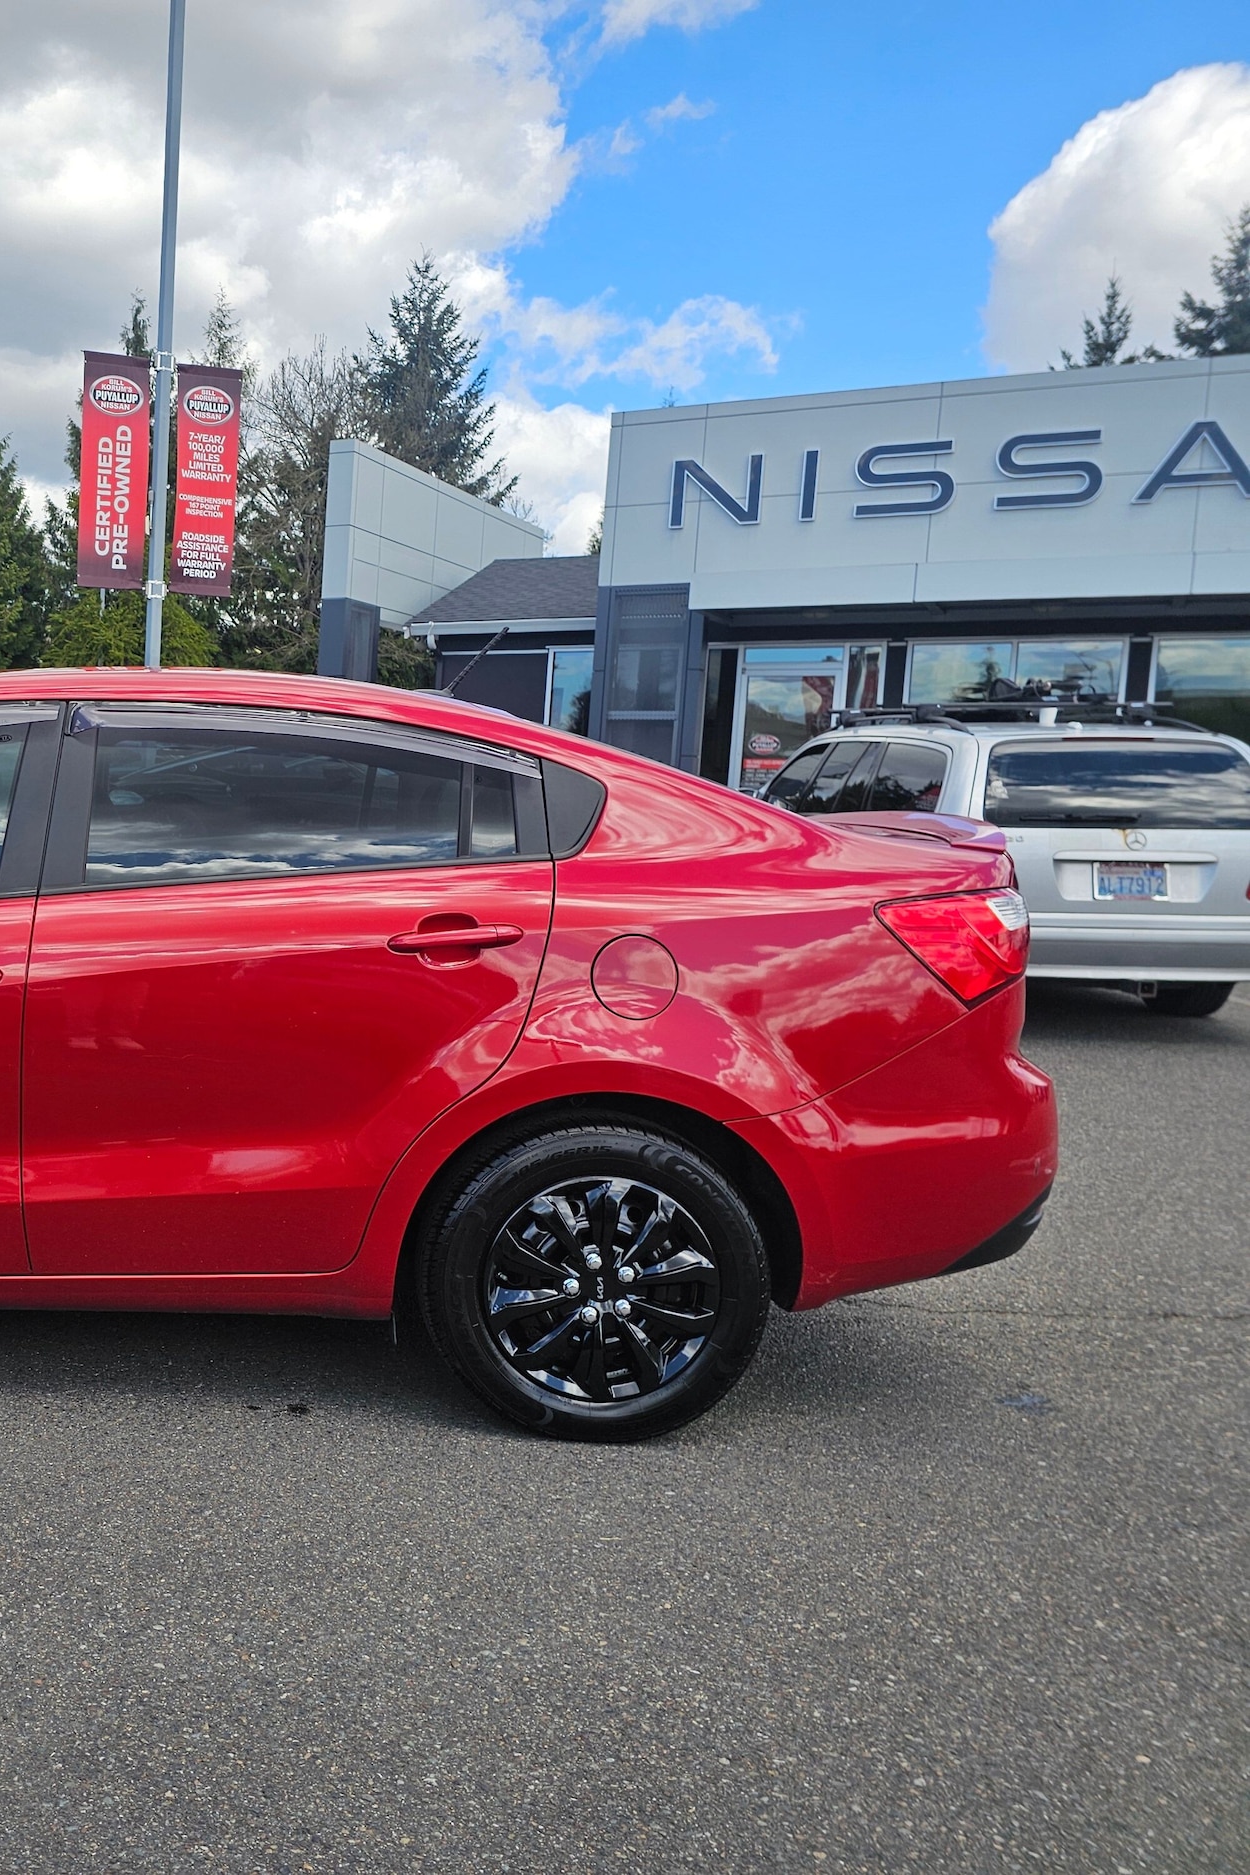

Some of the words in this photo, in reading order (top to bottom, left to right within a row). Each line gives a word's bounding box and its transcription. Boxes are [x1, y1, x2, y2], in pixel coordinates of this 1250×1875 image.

[101, 383, 133, 393] KORUM'S
[109, 378, 124, 386] BILL
[95, 389, 139, 404] PUYALLUP
[201, 389, 216, 397] BILL
[100, 401, 131, 411] NISSAN
[189, 399, 230, 414] PUYALLUP
[193, 410, 222, 420] NISSAN
[188, 431, 226, 445] 7-YEAR/
[187, 441, 225, 454] 100,000
[193, 451, 220, 463] MILES
[188, 460, 224, 473] LIMITED
[181, 468, 232, 483] WARRANTY
[668, 418, 1250, 530] NISSA
[94, 436, 113, 556] CERTIFIED
[111, 425, 132, 570] PRE-OWNED
[178, 493, 233, 506] COMPREHENSIVE
[185, 507, 223, 519] INSPECTION
[200, 503, 221, 511] POINT
[181, 531, 225, 544] ROADSIDE
[176, 540, 229, 553] ASSISTANCE
[181, 550, 199, 560] FOR
[199, 551, 221, 562] FULL
[176, 558, 227, 571] WARRANTY
[182, 567, 217, 579] PERIOD
